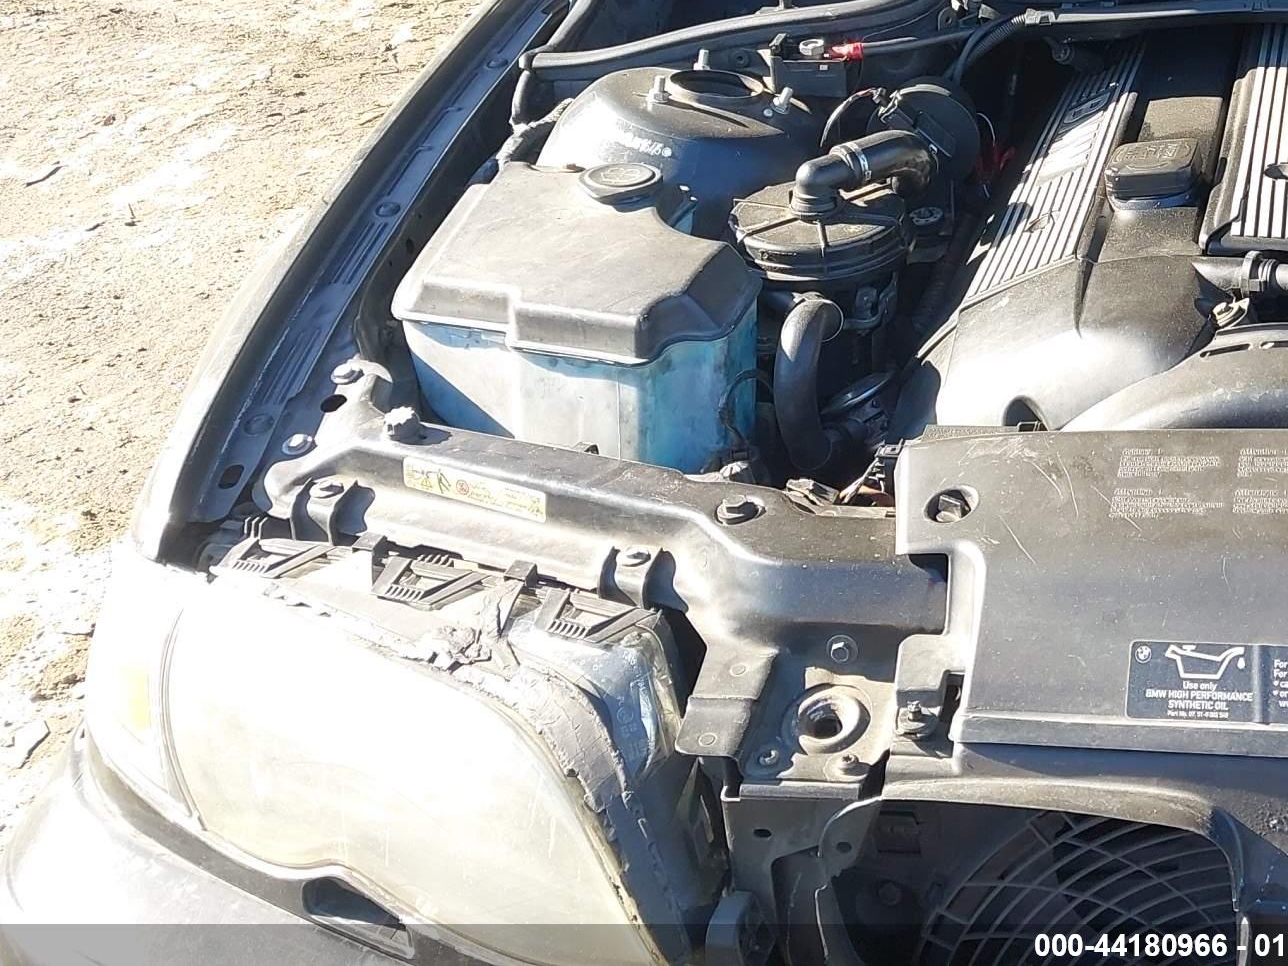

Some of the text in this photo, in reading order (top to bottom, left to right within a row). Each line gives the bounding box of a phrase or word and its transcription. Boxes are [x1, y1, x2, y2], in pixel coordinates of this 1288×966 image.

[1273, 659, 1288, 669] For
[1273, 669, 1287, 678] For
[1183, 681, 1218, 692] Use only
[1145, 689, 1254, 702] BMW HIGH PERFORMANCE
[1168, 700, 1229, 711] SYNTHETIC OIL
